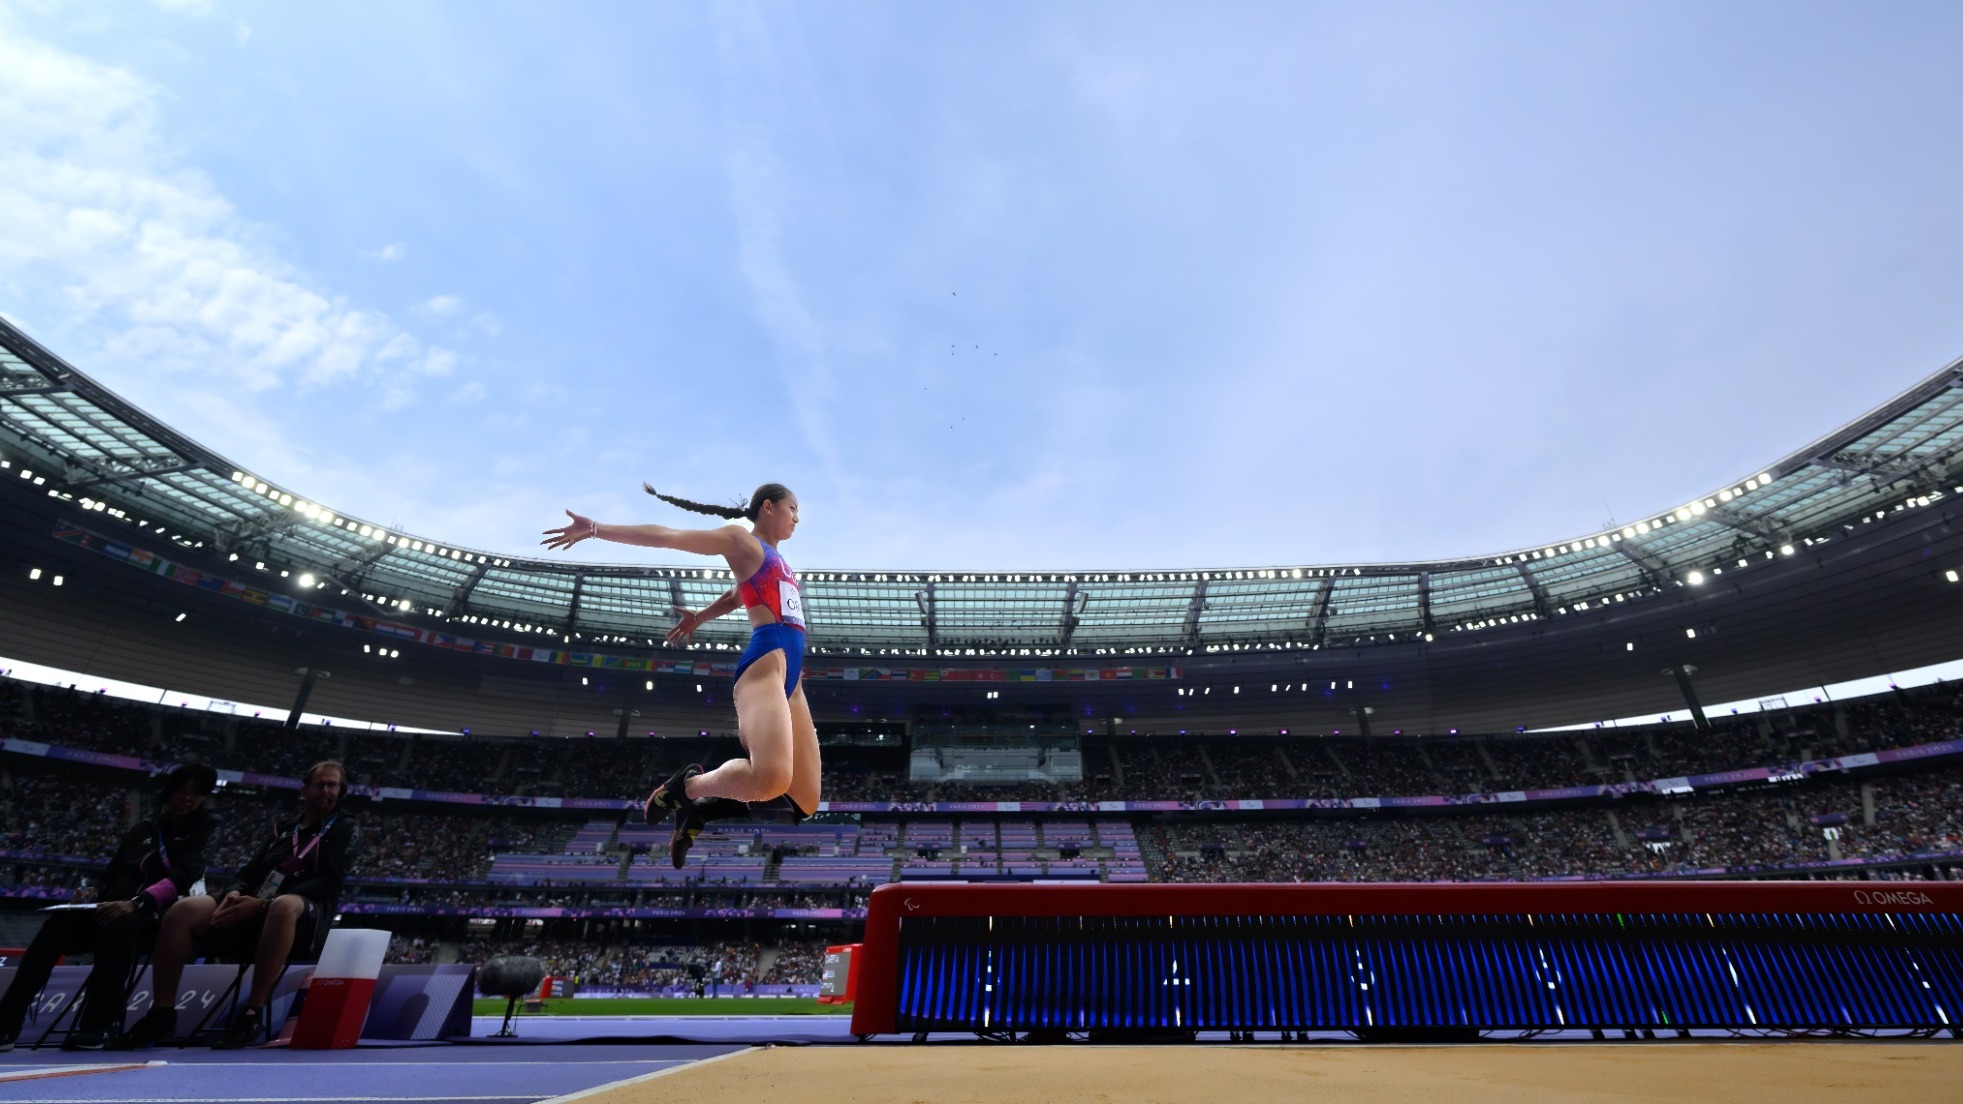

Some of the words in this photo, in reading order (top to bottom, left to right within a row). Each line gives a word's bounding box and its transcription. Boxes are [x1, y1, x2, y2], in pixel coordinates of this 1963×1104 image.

[1872, 891, 1934, 905] OMEGA
[31, 993, 86, 1014] PAR
[125, 990, 216, 1011] 224
